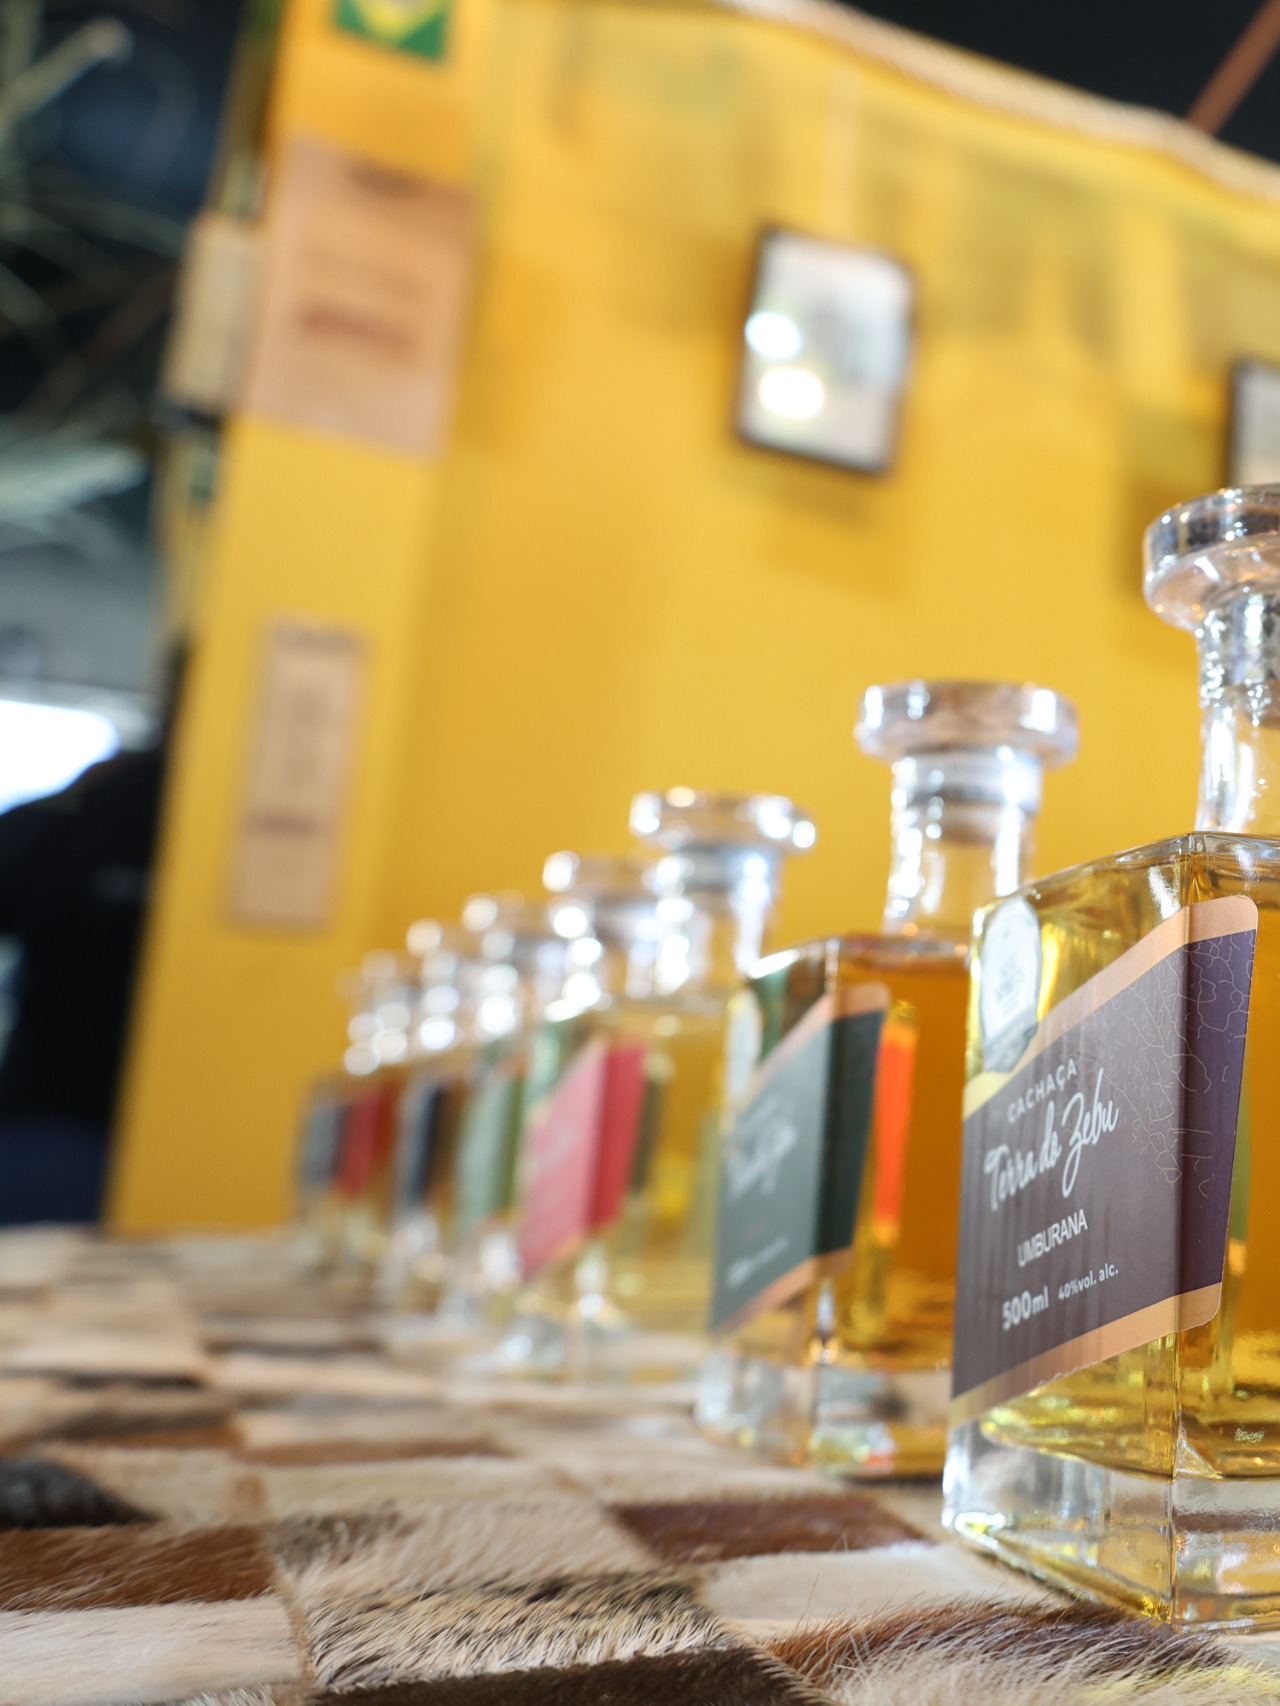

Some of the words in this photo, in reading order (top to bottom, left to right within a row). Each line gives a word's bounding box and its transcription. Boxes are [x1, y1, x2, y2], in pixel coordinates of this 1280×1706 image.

[1007, 1058, 1078, 1124] CACHAÇA
[984, 1143, 1039, 1212] Terra
[1038, 1099, 1063, 1176] do
[1061, 1066, 1119, 1199] Zebu
[1017, 1208, 1089, 1268] UMBURANA
[1002, 1285, 1050, 1331] 500ml
[1057, 1270, 1098, 1301] 40%vol.
[1098, 1262, 1119, 1284] alc.
